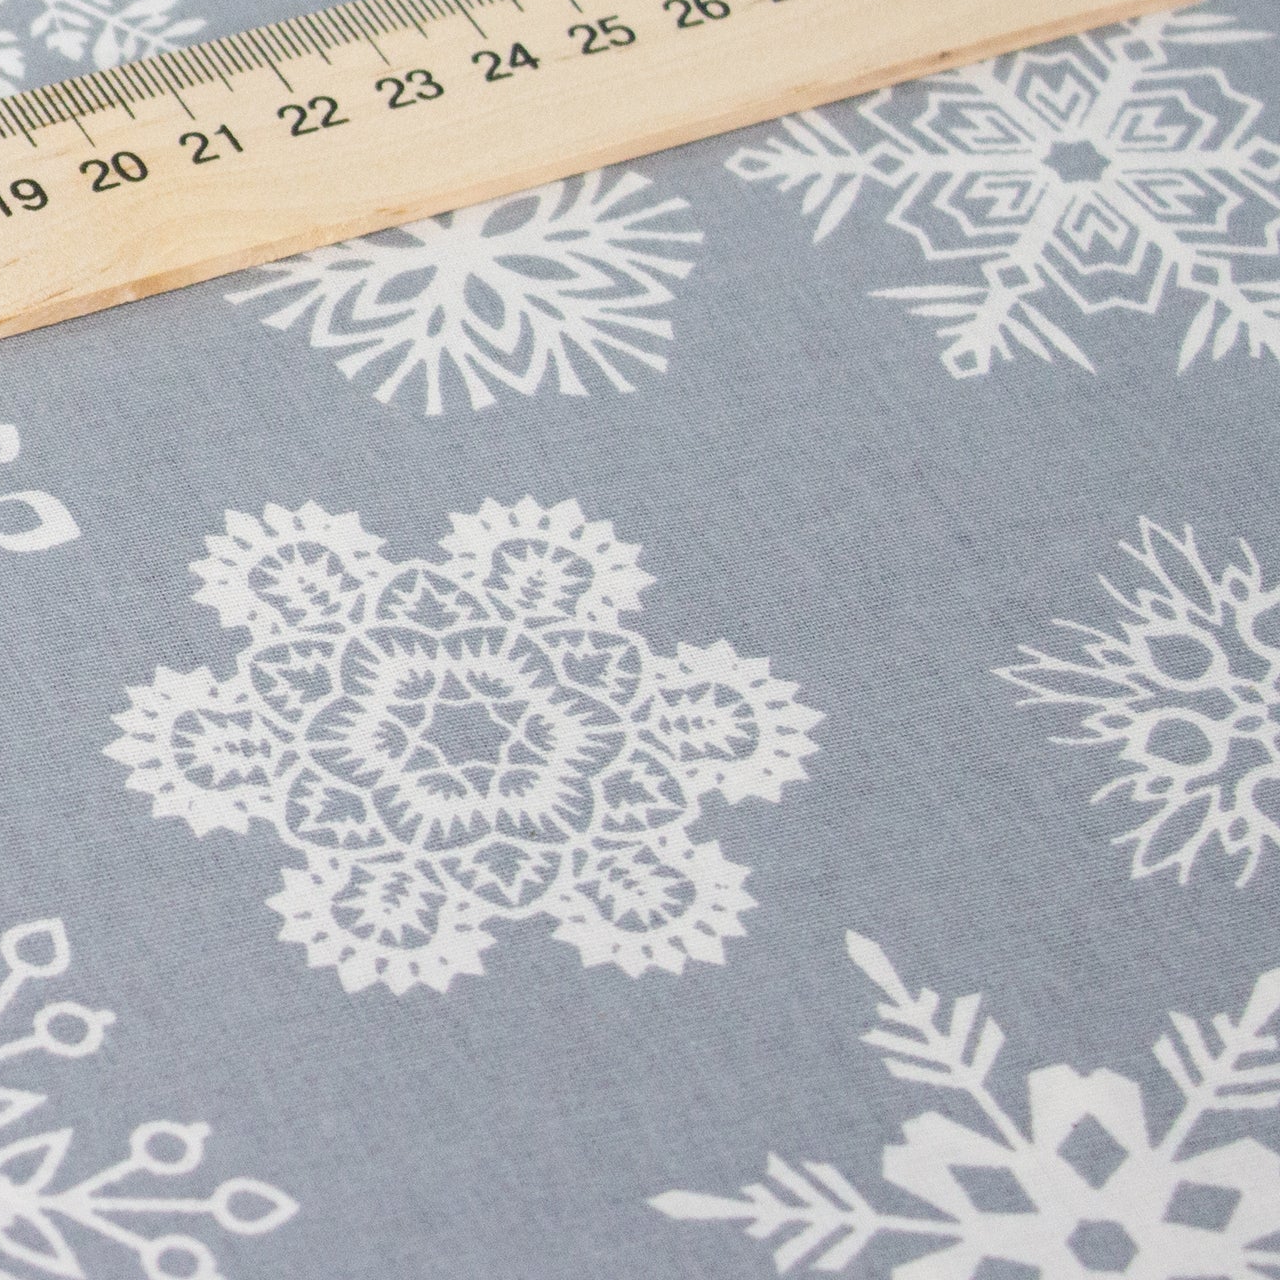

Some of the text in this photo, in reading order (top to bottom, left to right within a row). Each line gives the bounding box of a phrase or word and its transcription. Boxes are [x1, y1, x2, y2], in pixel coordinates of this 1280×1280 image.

[78, 151, 149, 193] 20
[178, 124, 244, 165] 21
[276, 95, 350, 137] 22
[374, 69, 445, 110] 23
[471, 42, 541, 83] 24
[567, 15, 637, 56] 25
